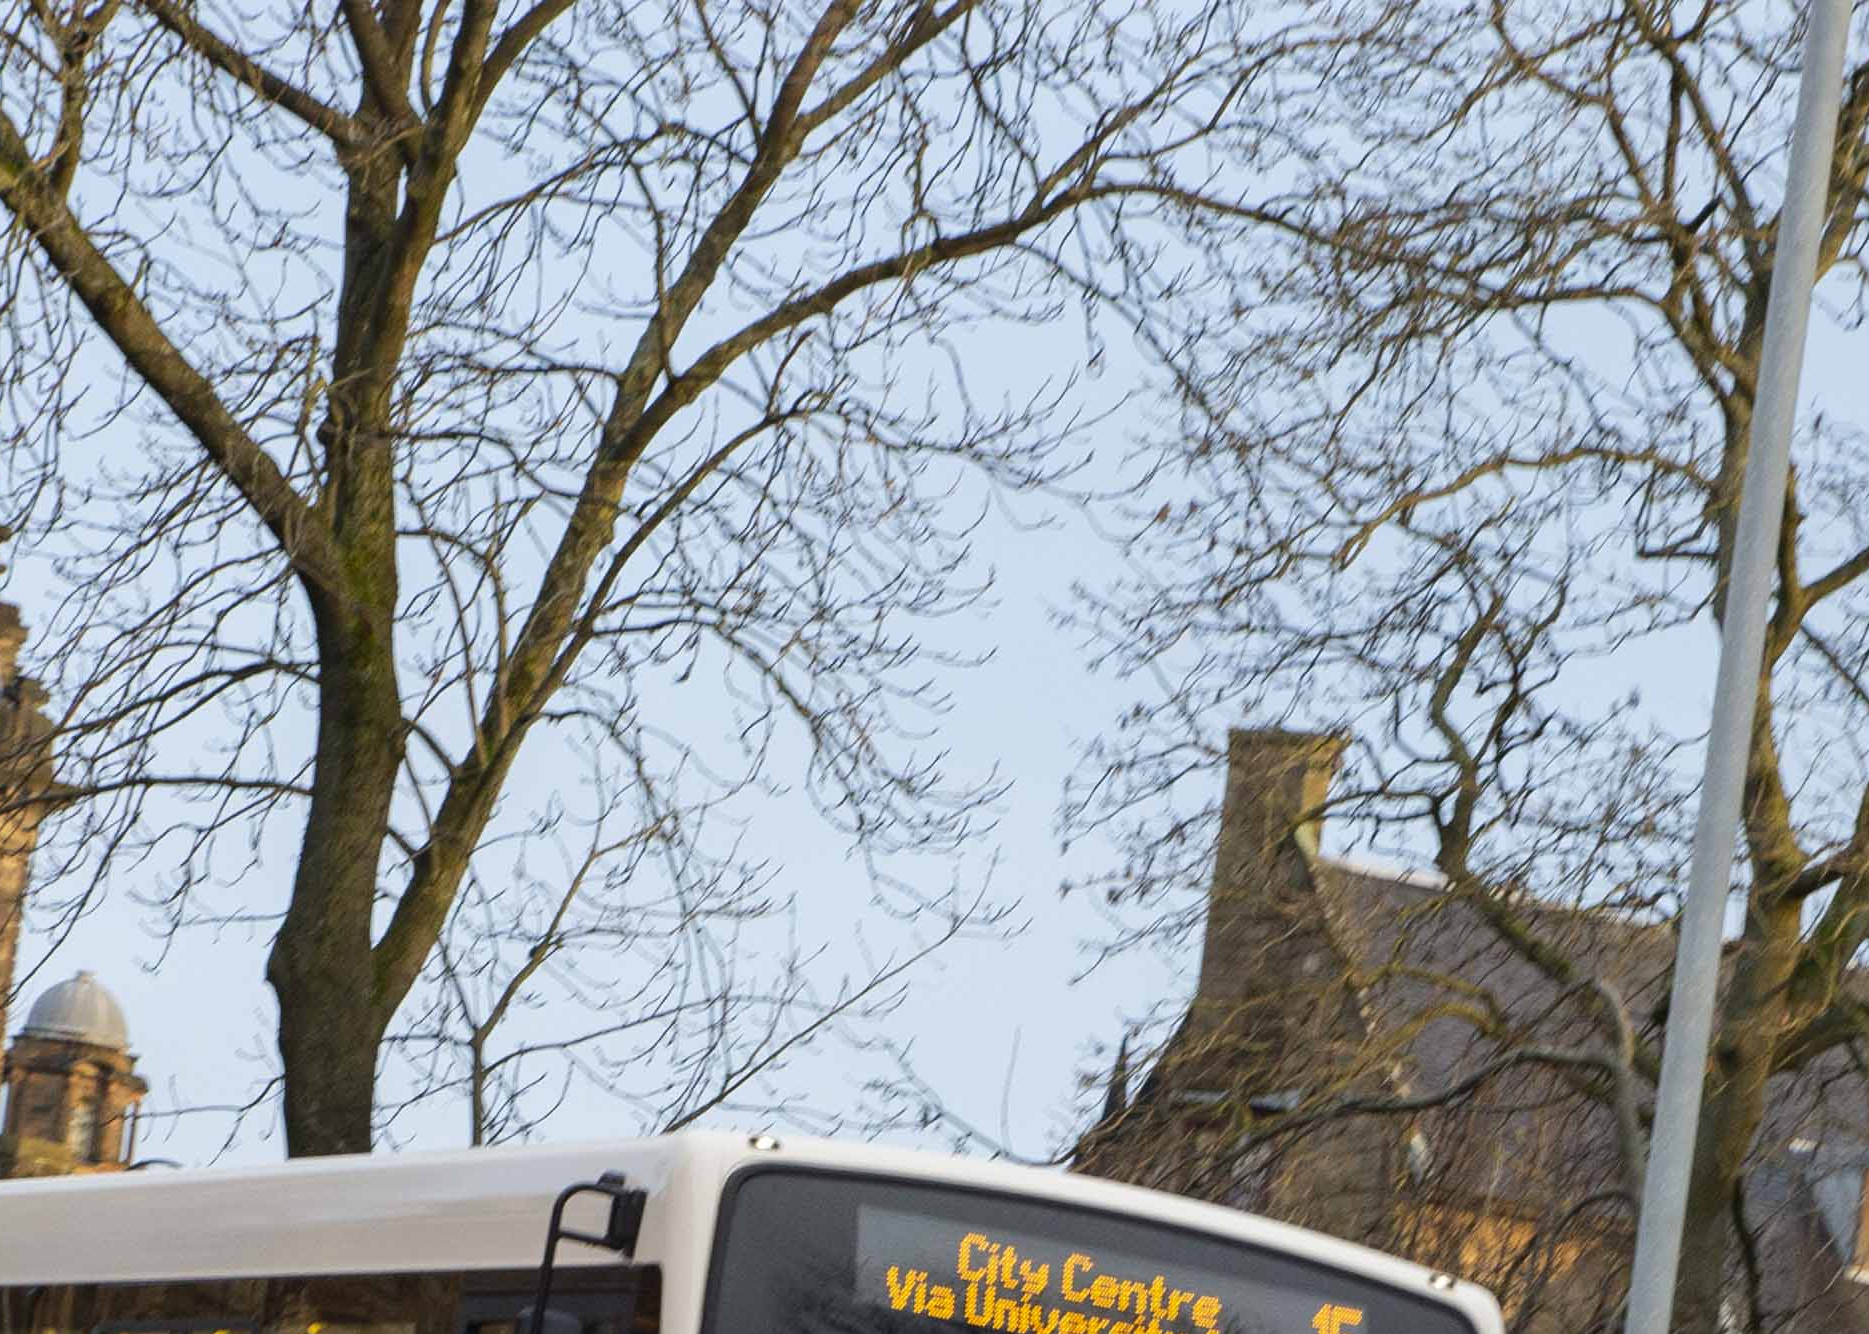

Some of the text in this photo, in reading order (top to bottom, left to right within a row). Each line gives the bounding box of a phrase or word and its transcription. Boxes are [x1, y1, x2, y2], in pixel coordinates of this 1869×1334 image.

[885, 1264, 956, 1320] Via
[959, 1232, 1222, 1329] City Centre
